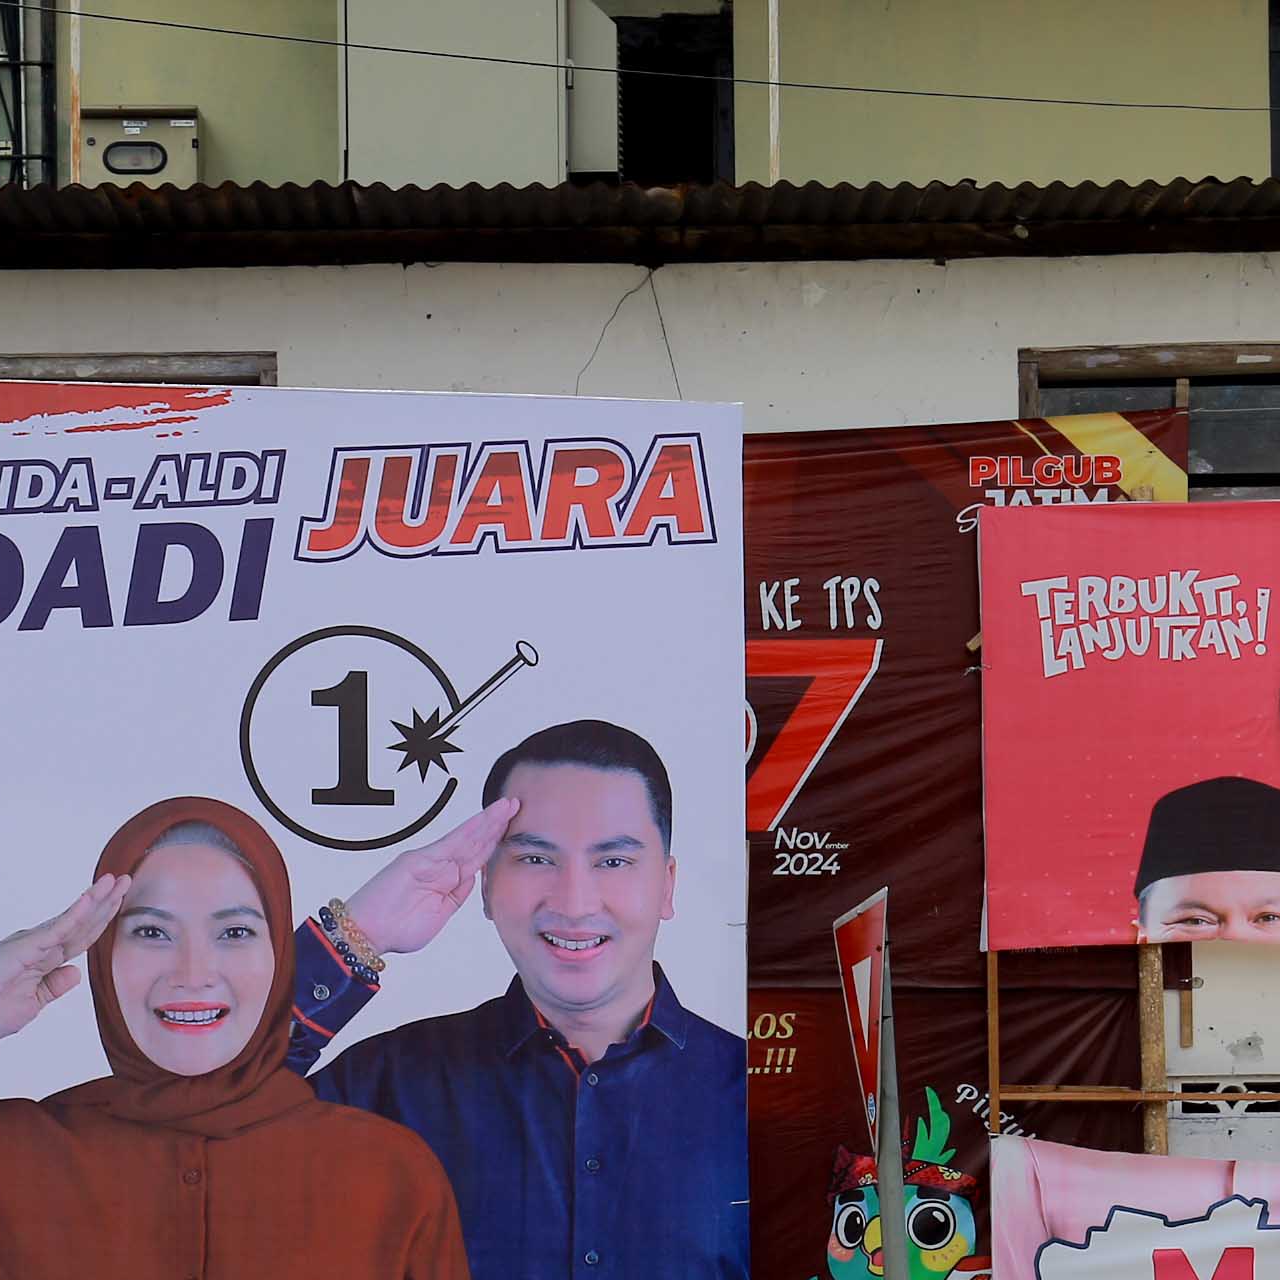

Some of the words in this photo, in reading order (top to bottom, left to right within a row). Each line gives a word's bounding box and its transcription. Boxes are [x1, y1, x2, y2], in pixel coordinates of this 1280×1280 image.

[970, 455, 1123, 487] PILGUB
[294, 432, 718, 563] JUARA
[759, 577, 802, 631] KE
[823, 575, 883, 631] TPS
[310, 669, 396, 807] 1
[772, 853, 841, 876] 2024
[748, 1012, 797, 1039] OS
